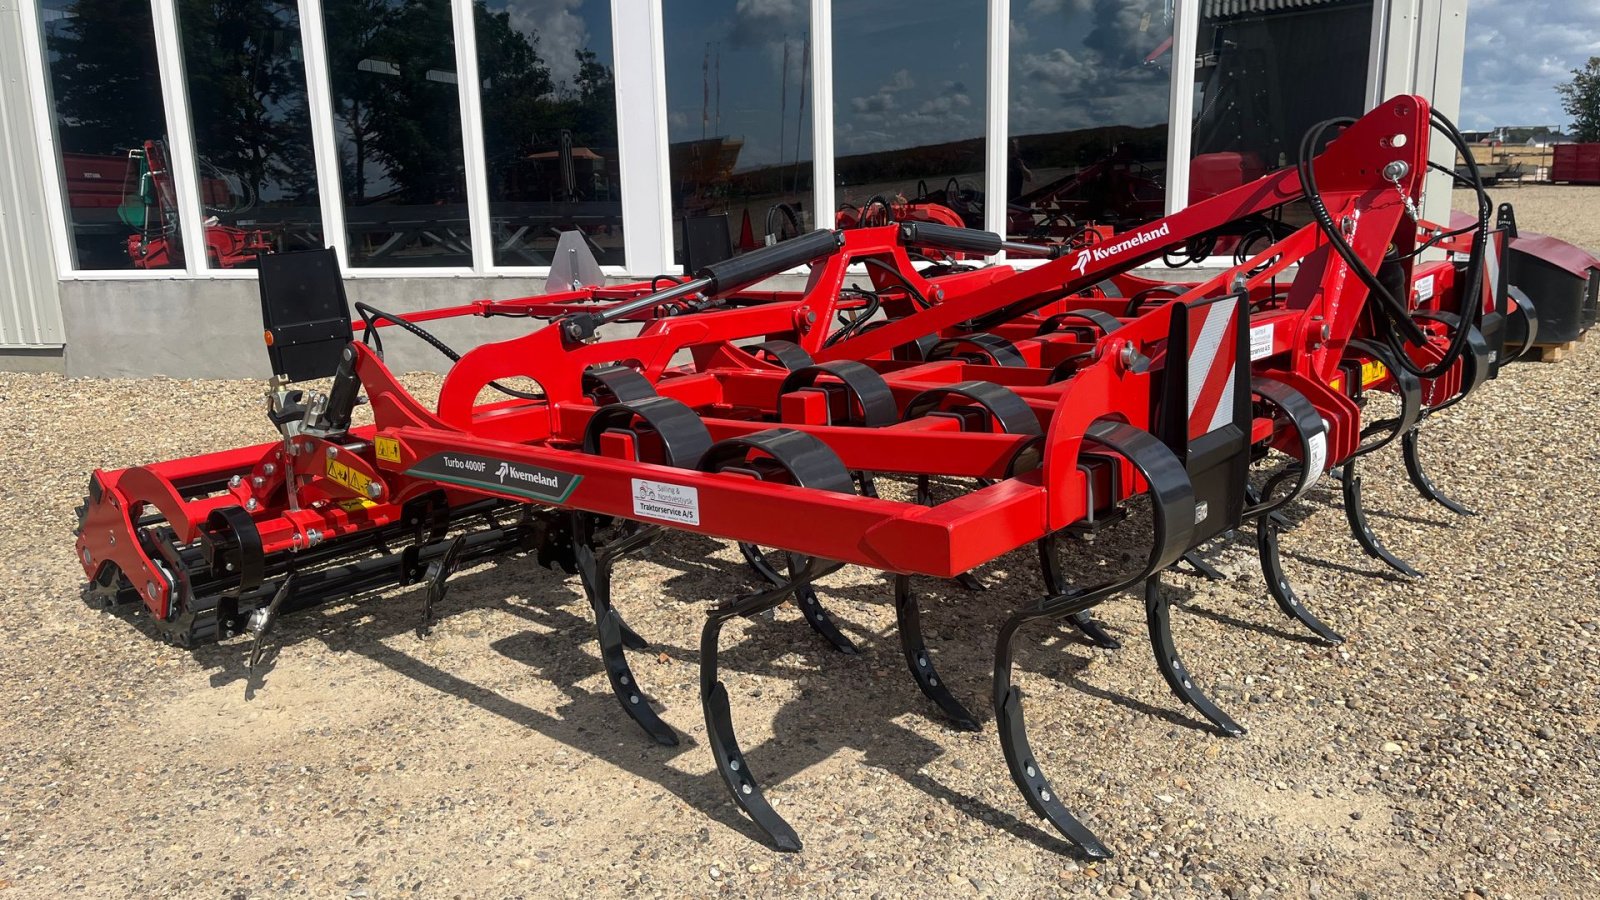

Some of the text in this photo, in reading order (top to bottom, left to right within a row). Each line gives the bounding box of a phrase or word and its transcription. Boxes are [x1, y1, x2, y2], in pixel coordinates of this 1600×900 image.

[1092, 222, 1170, 262] Kverneland
[443, 456, 486, 473] Turbo 4000F
[509, 466, 558, 488] Kverneland
[640, 503, 682, 516] Traktorservice
[682, 510, 693, 518] A/S
